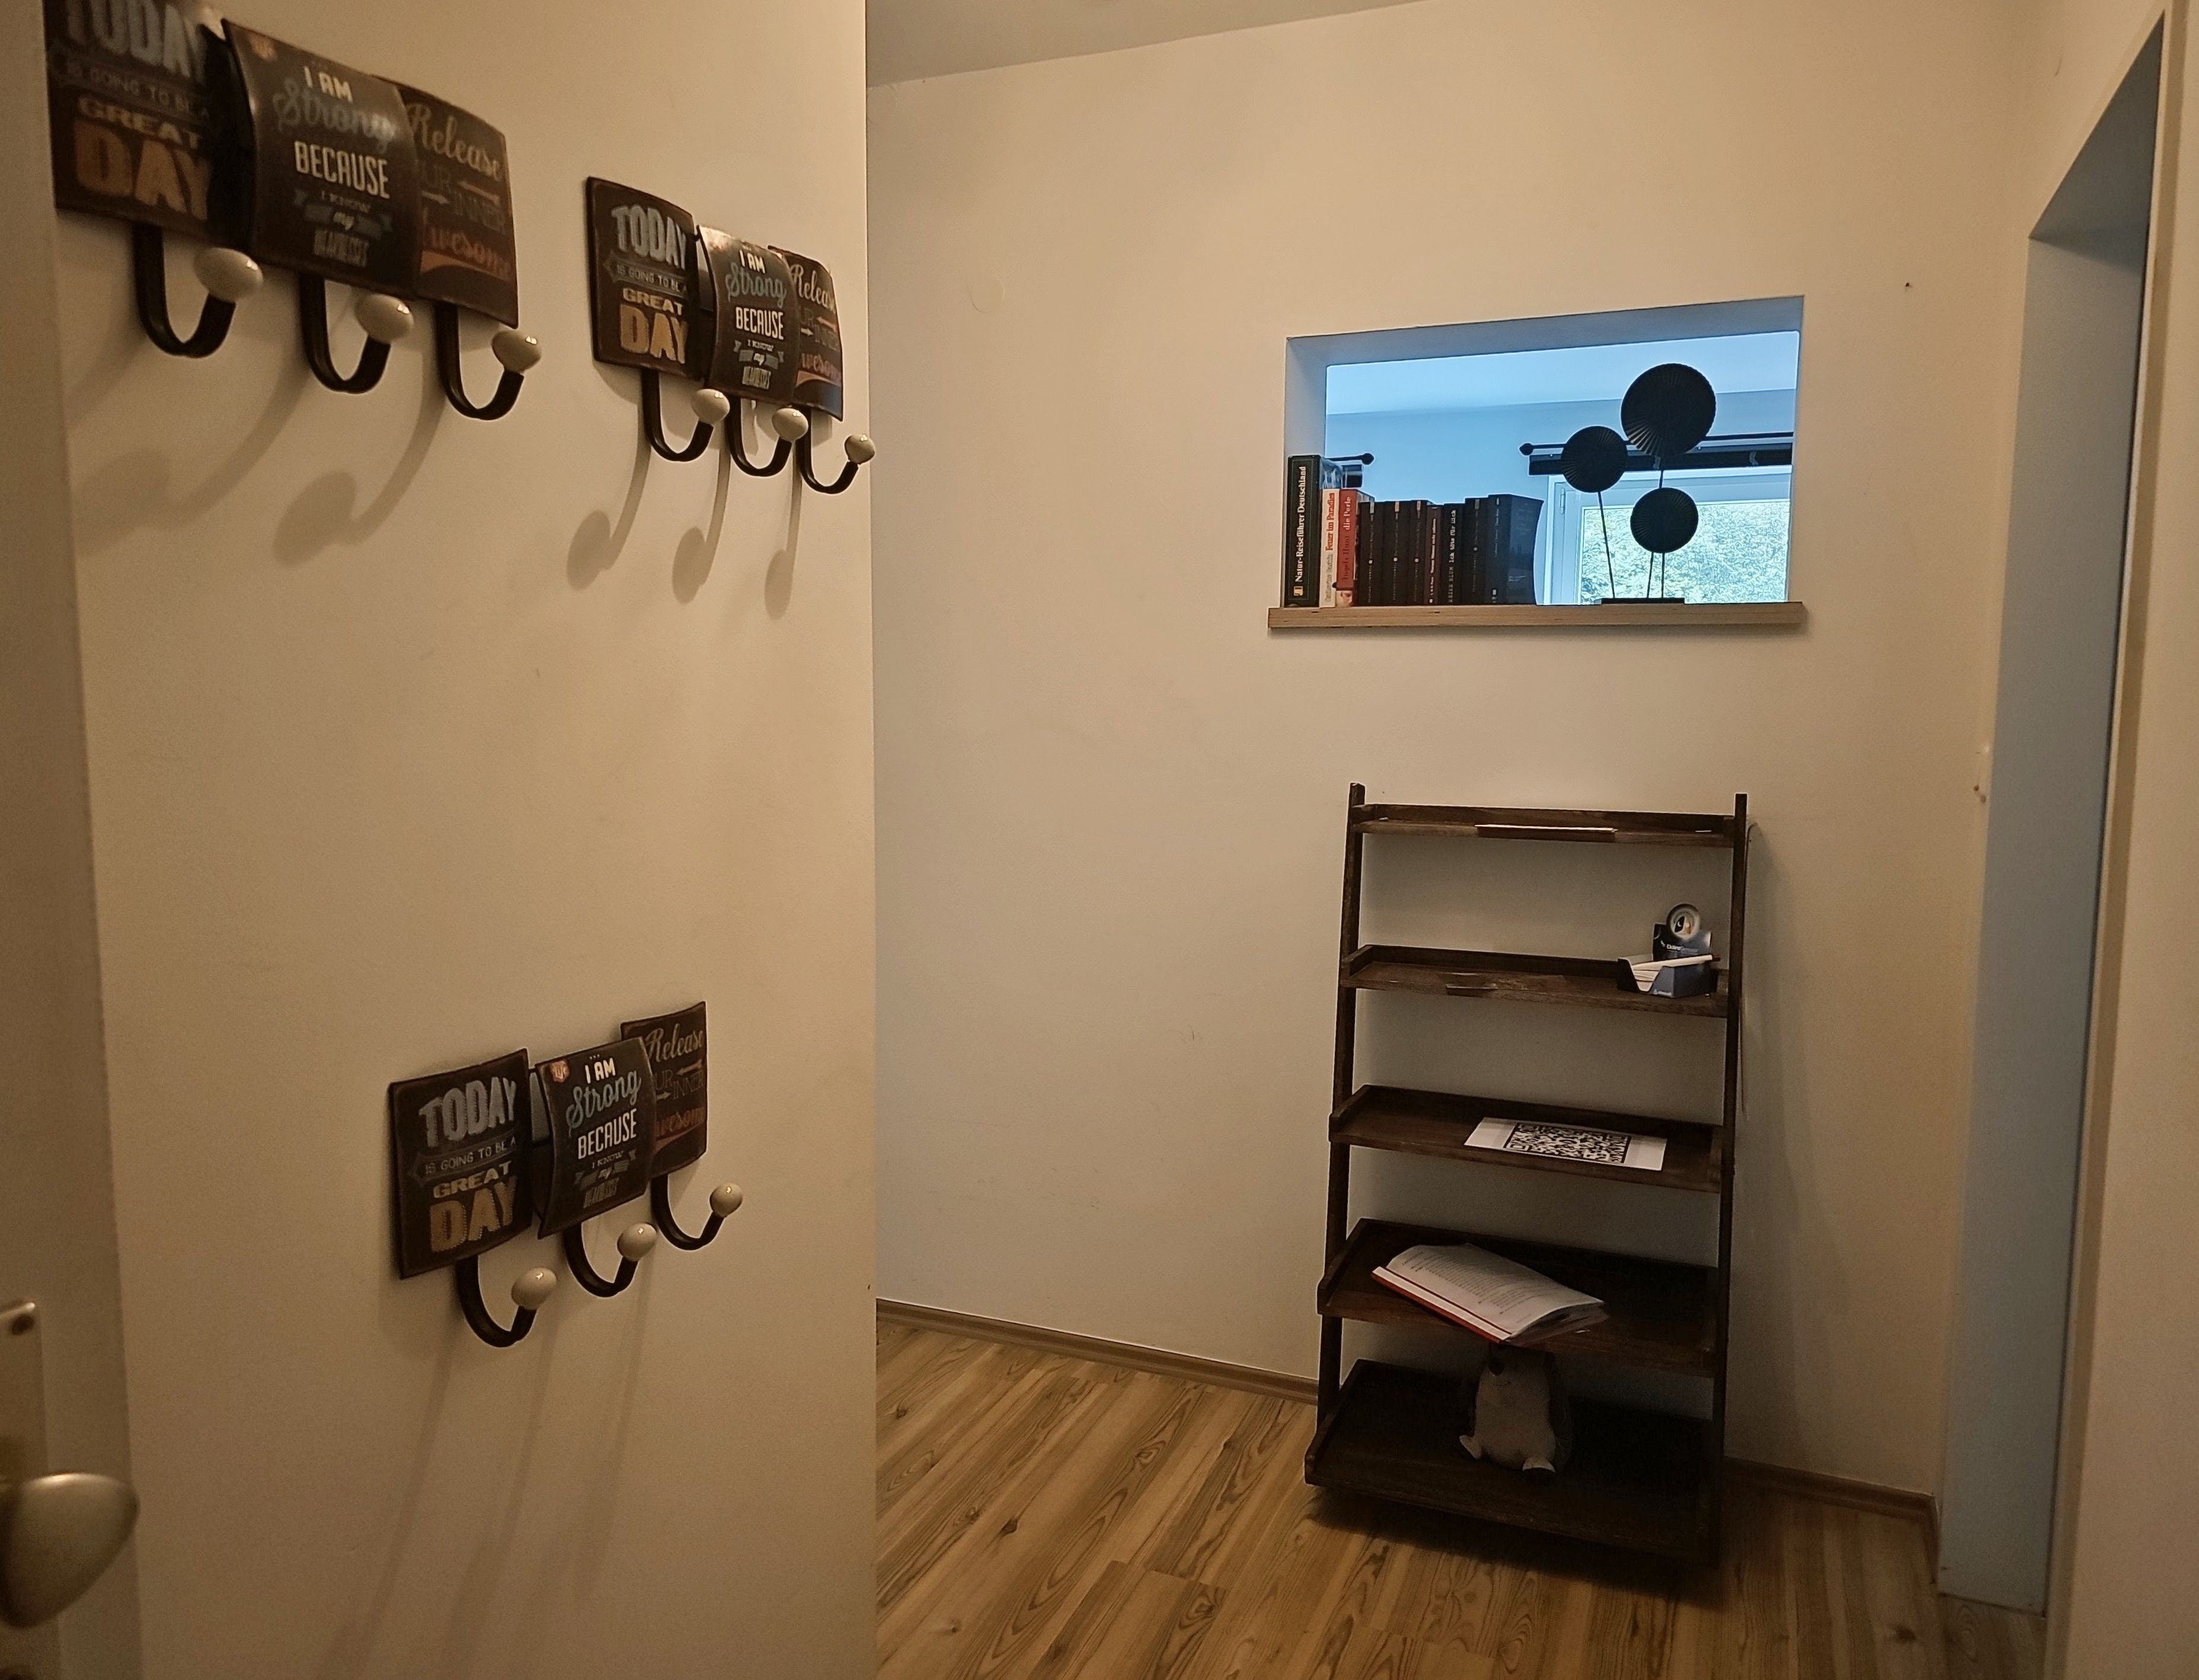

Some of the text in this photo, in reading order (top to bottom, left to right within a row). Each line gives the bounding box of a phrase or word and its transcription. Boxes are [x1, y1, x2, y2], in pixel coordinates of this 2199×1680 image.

[304, 66, 353, 104] I AM
[78, 96, 203, 150] GREAT
[405, 103, 502, 182] Release
[73, 118, 212, 221] DAY
[294, 140, 391, 199] BECAUSE
[611, 203, 686, 271] TODAY
[629, 268, 654, 284] GOING
[657, 276, 669, 287] TO
[739, 249, 766, 274] I AM
[623, 287, 685, 316] GREAT
[725, 262, 787, 308] Strong
[619, 303, 689, 364] DAY
[735, 306, 784, 341] BECAUSE
[1297, 466, 1306, 513] Deutschland
[1343, 497, 1351, 517] Perle
[1326, 521, 1334, 532] im
[644, 1022, 704, 1063] Release
[584, 1057, 616, 1084] I AM
[418, 1076, 517, 1148] TODAY
[565, 1069, 643, 1138] Strong
[440, 1151, 474, 1170] GOING
[478, 1145, 493, 1159] TO
[496, 1140, 507, 1154] BE
[577, 1107, 638, 1160] BECAUSE
[433, 1160, 512, 1199] GREAT
[430, 1175, 518, 1253] DAY
